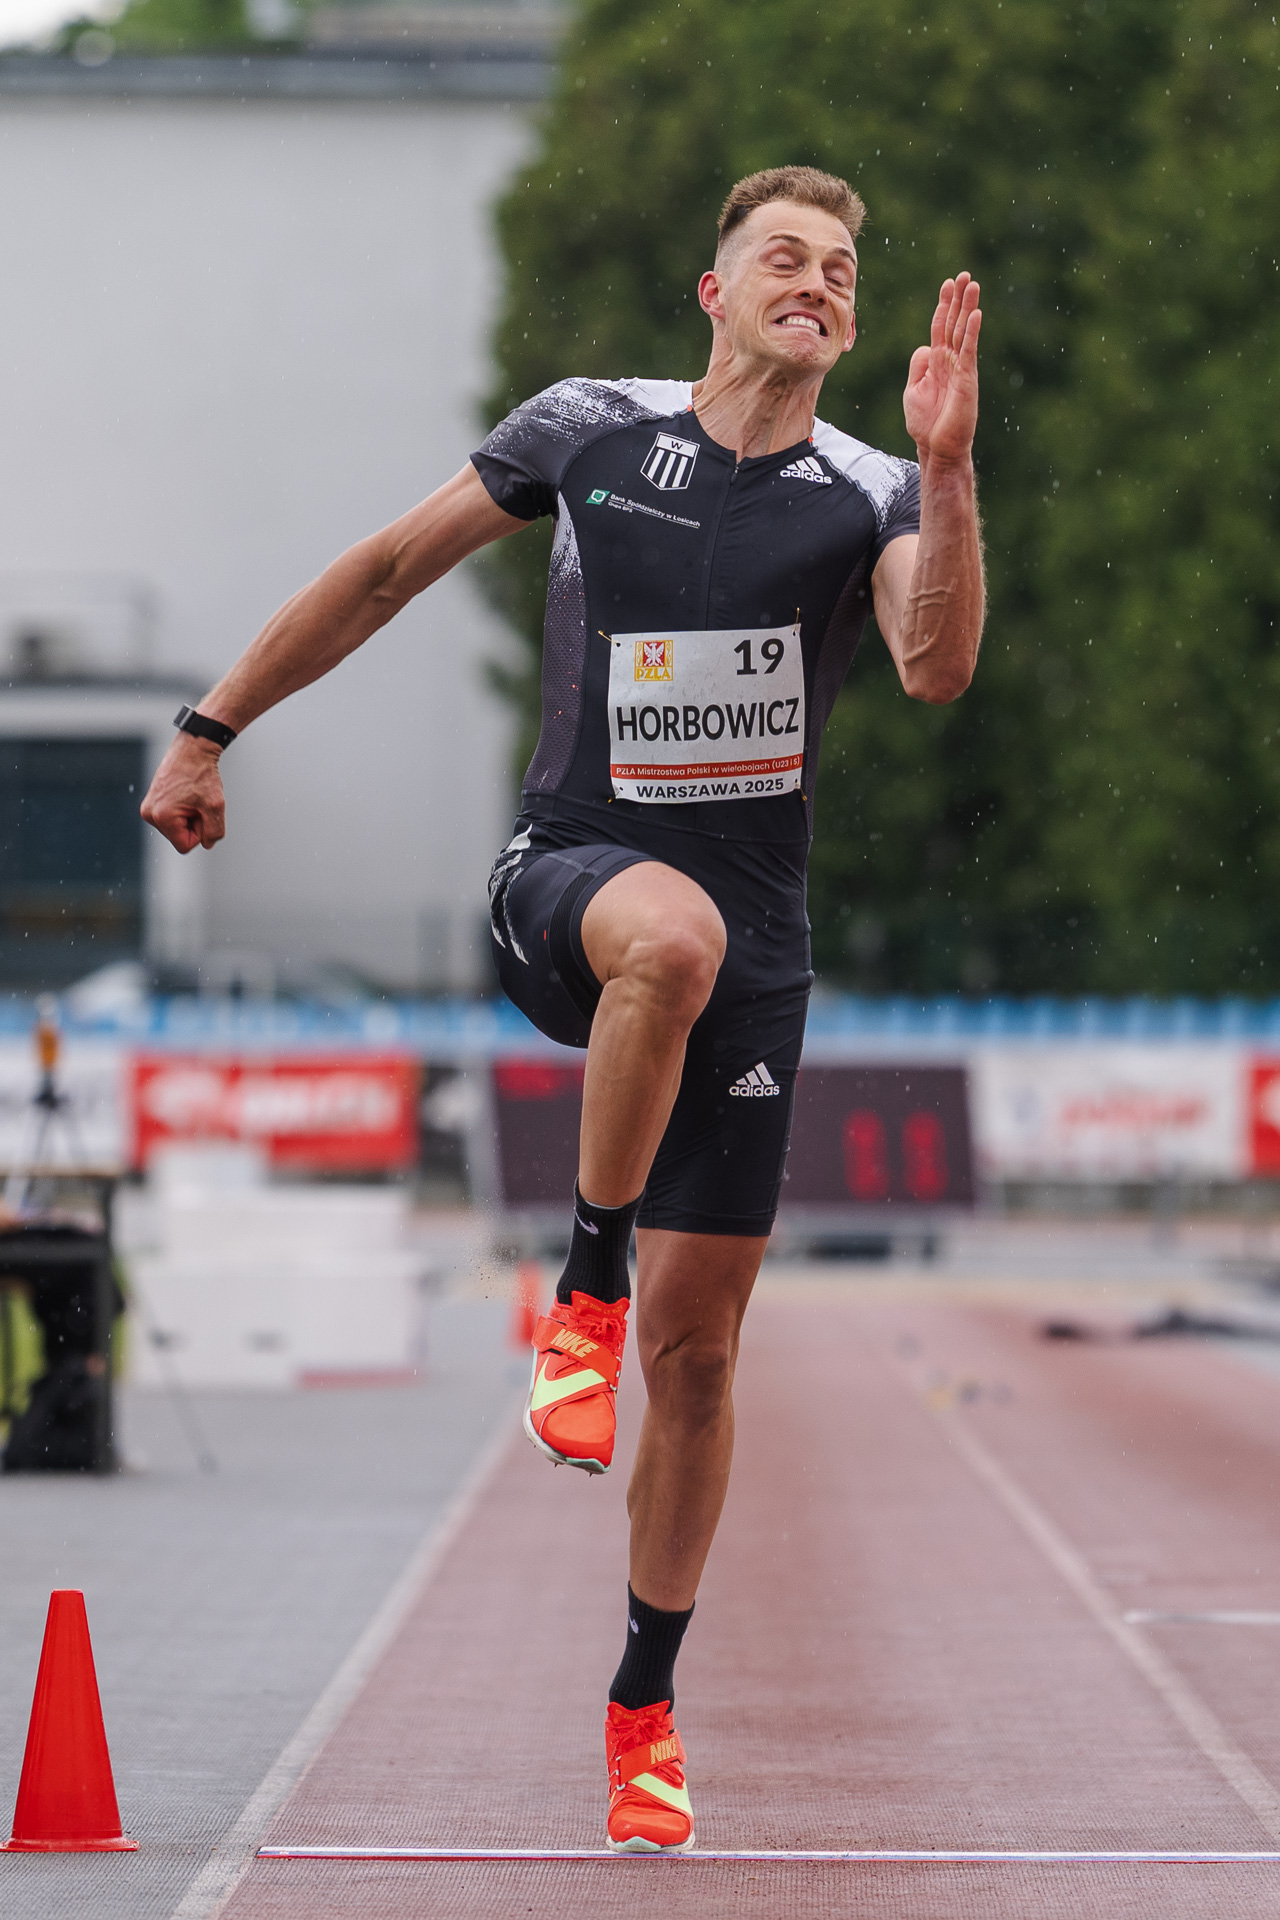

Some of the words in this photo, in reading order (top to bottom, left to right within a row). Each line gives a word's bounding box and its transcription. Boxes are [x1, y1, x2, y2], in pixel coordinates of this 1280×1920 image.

[671, 441, 683, 450] W
[780, 469, 832, 484] adidas
[610, 494, 626, 503] Bank
[734, 638, 785, 675] 19
[636, 667, 671, 679] PZLA
[616, 697, 800, 742] HORBOWICZ
[616, 767, 636, 776] PZLA
[637, 767, 686, 776] Mistrzostwa
[686, 765, 711, 775] Polski
[712, 766, 720, 774] w
[720, 761, 770, 773] wielobojach
[771, 759, 789, 770] (U23
[636, 782, 741, 799] WARSZAWA
[744, 778, 784, 794] 2025
[729, 1084, 780, 1097] adidas
[550, 1328, 600, 1358] NIKE
